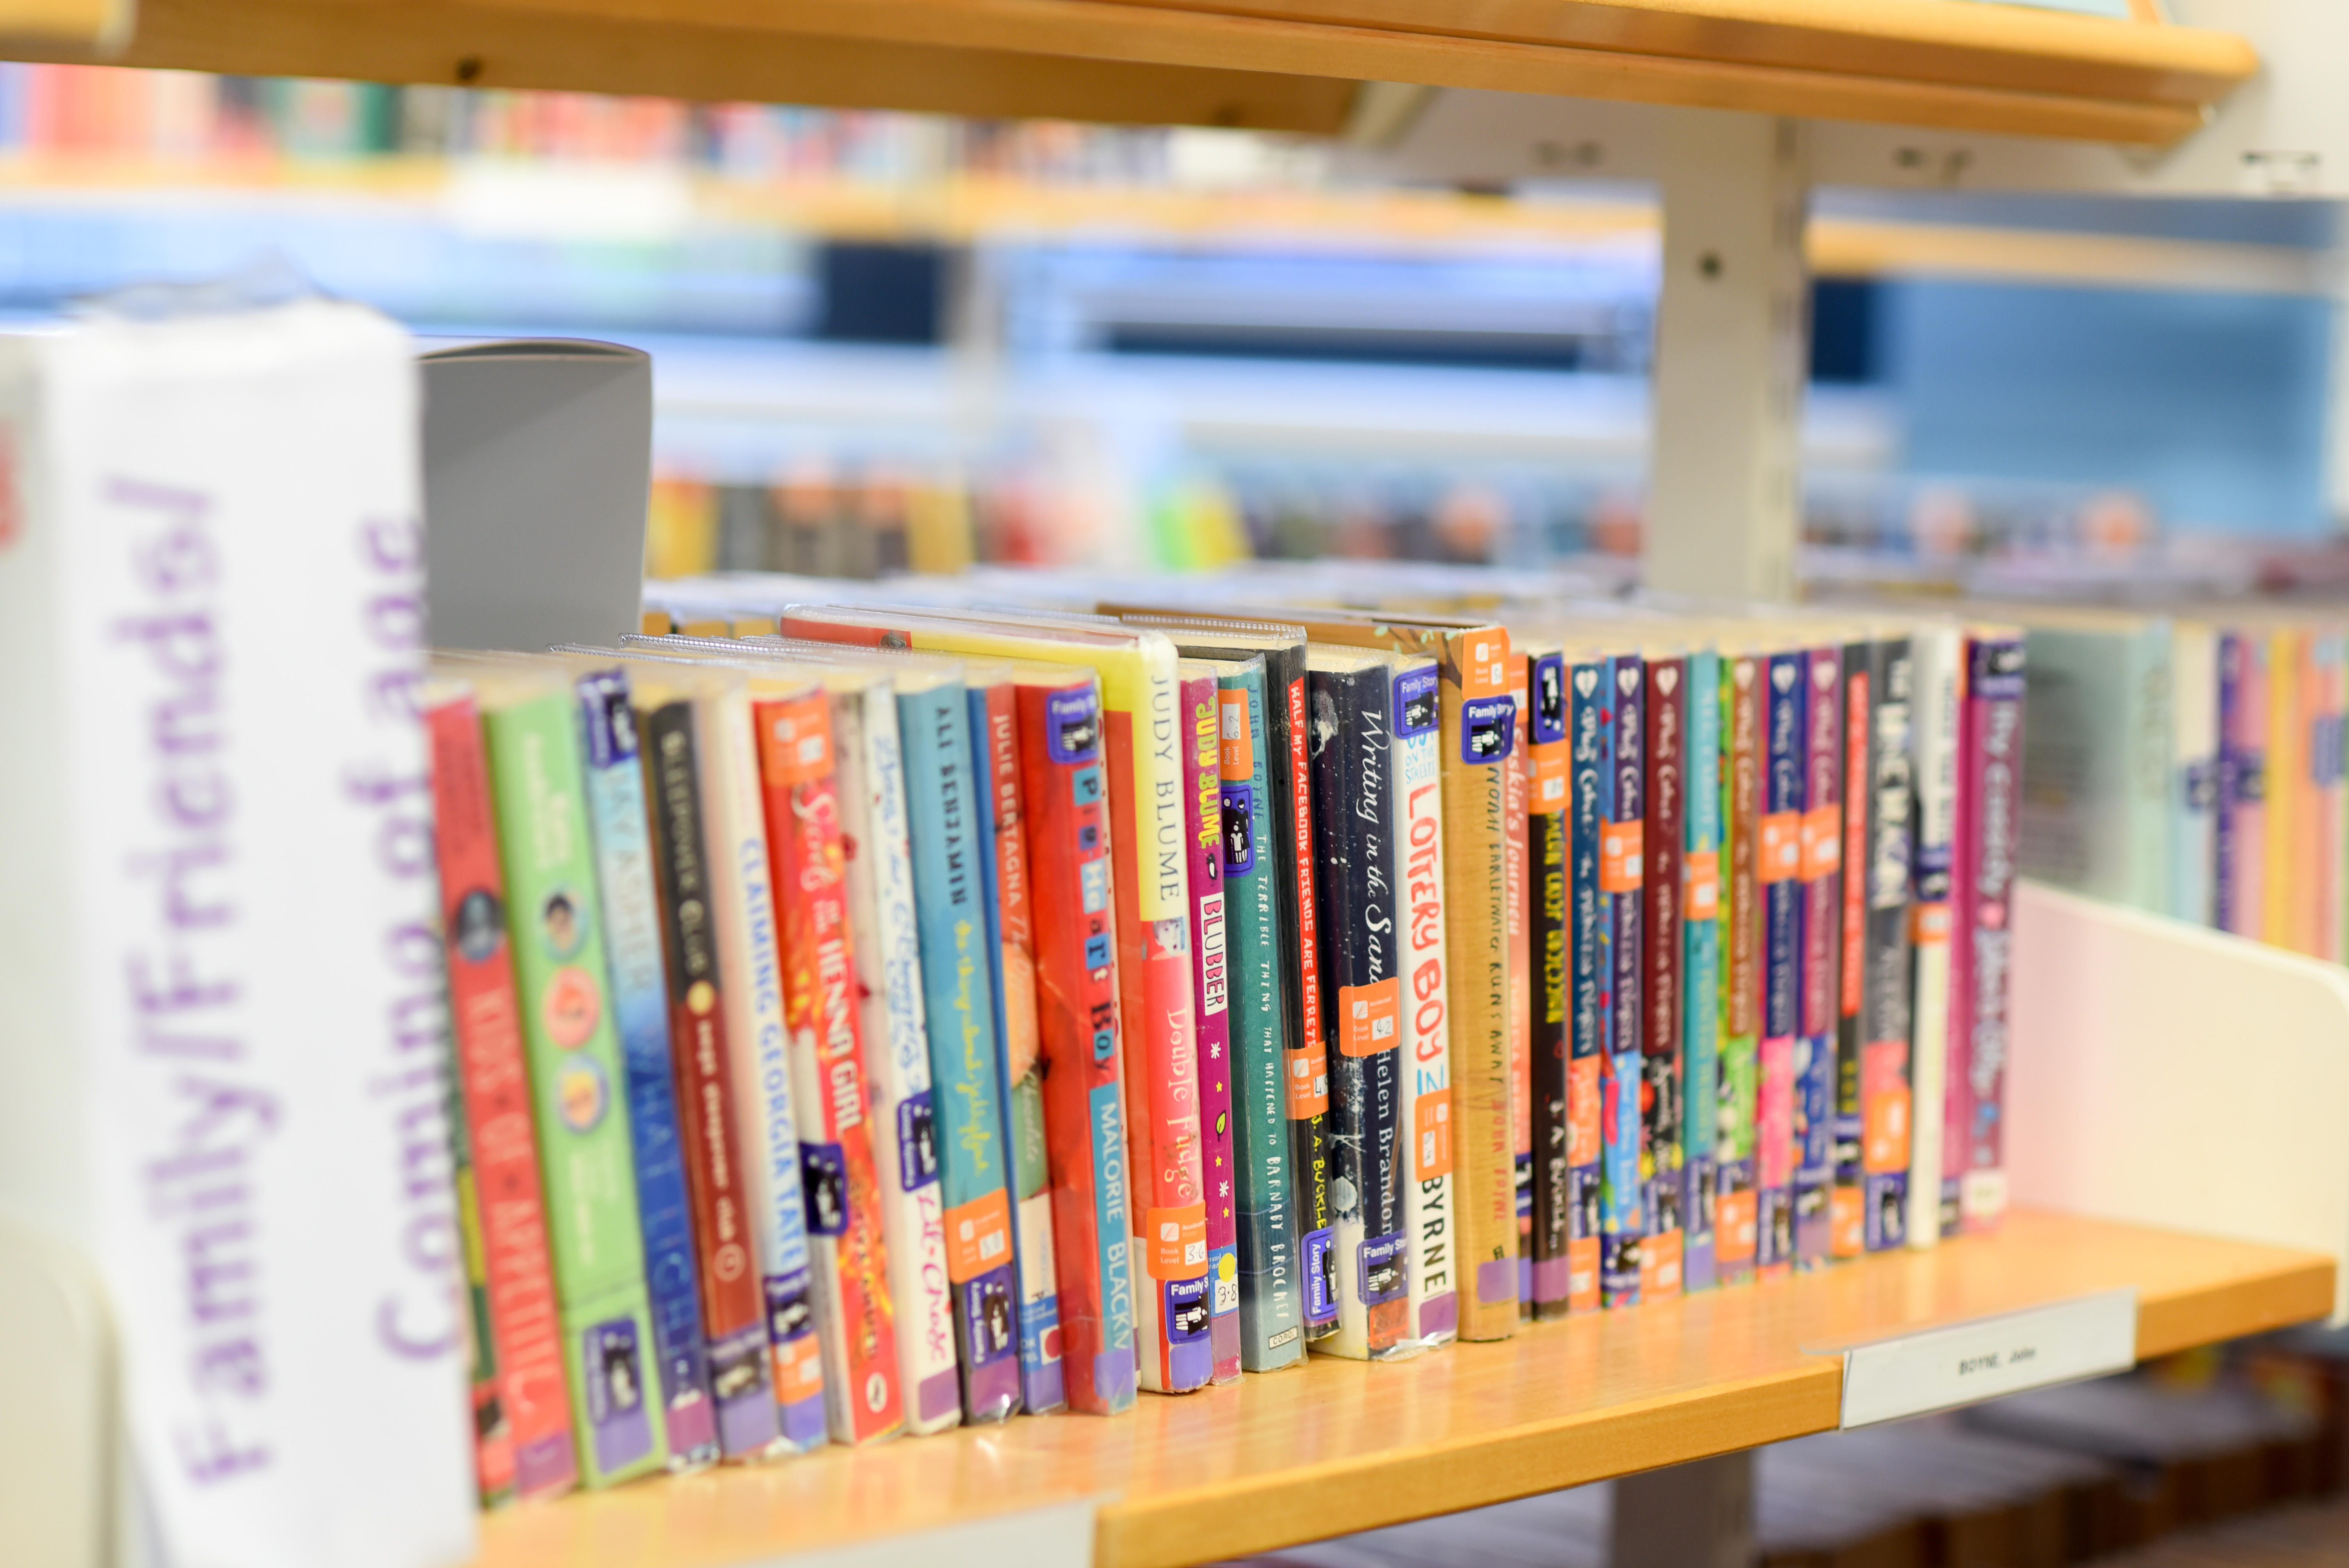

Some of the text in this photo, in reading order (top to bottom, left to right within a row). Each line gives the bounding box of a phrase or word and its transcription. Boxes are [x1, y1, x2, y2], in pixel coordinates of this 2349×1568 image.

[1402, 680, 1422, 693] Family
[1468, 704, 1496, 719] Family
[936, 707, 967, 906] ALI BENJAMIN
[993, 715, 1022, 908] JULIE BERTAGNA
[1150, 675, 1180, 901] JUDY BLUME
[1195, 695, 1221, 850] JUDY BLUME
[1356, 709, 1392, 898] Writing in the
[1406, 751, 1419, 766] ON
[1485, 766, 1501, 832] NOAH
[791, 786, 841, 893] Secrets
[1290, 686, 1317, 1046] HALF MY FACEBOOK FRIENDS ARE FERRETS
[1408, 783, 1440, 951] LOTTERY
[1503, 725, 1524, 935] Saskia's Journey
[741, 837, 777, 1014] CLAIMING
[1203, 899, 1225, 1008] BLUBBER
[816, 938, 856, 1056] HENNA
[1247, 685, 1290, 1319] JOHN BOYNE THE TERRIBLE THING THAT HAPPENED TO BARNABY BROCKET
[1412, 958, 1445, 1062] BOY
[1491, 962, 1506, 1021] RUNS
[757, 1022, 795, 1179] GEORGIA
[830, 1059, 863, 1135] GIRL
[1164, 1008, 1197, 1199] Double Fudge
[1377, 1049, 1392, 1120] Helen
[1489, 1030, 1506, 1086] AWAY
[1021, 1070, 1042, 1164] Chocolate
[1101, 1101, 1123, 1224] MALORIE
[1491, 1099, 1506, 1153] JOHN
[1311, 1114, 1328, 1230] J. A. BUCKLE
[1549, 1157, 1567, 1232] BUCKLE
[1311, 1243, 1321, 1314] Family Story
[1363, 1244, 1395, 1258] Family
[1422, 1175, 1446, 1292] BYRNE
[1171, 1280, 1204, 1296] Family
[1273, 1329, 1294, 1345] CORGI
